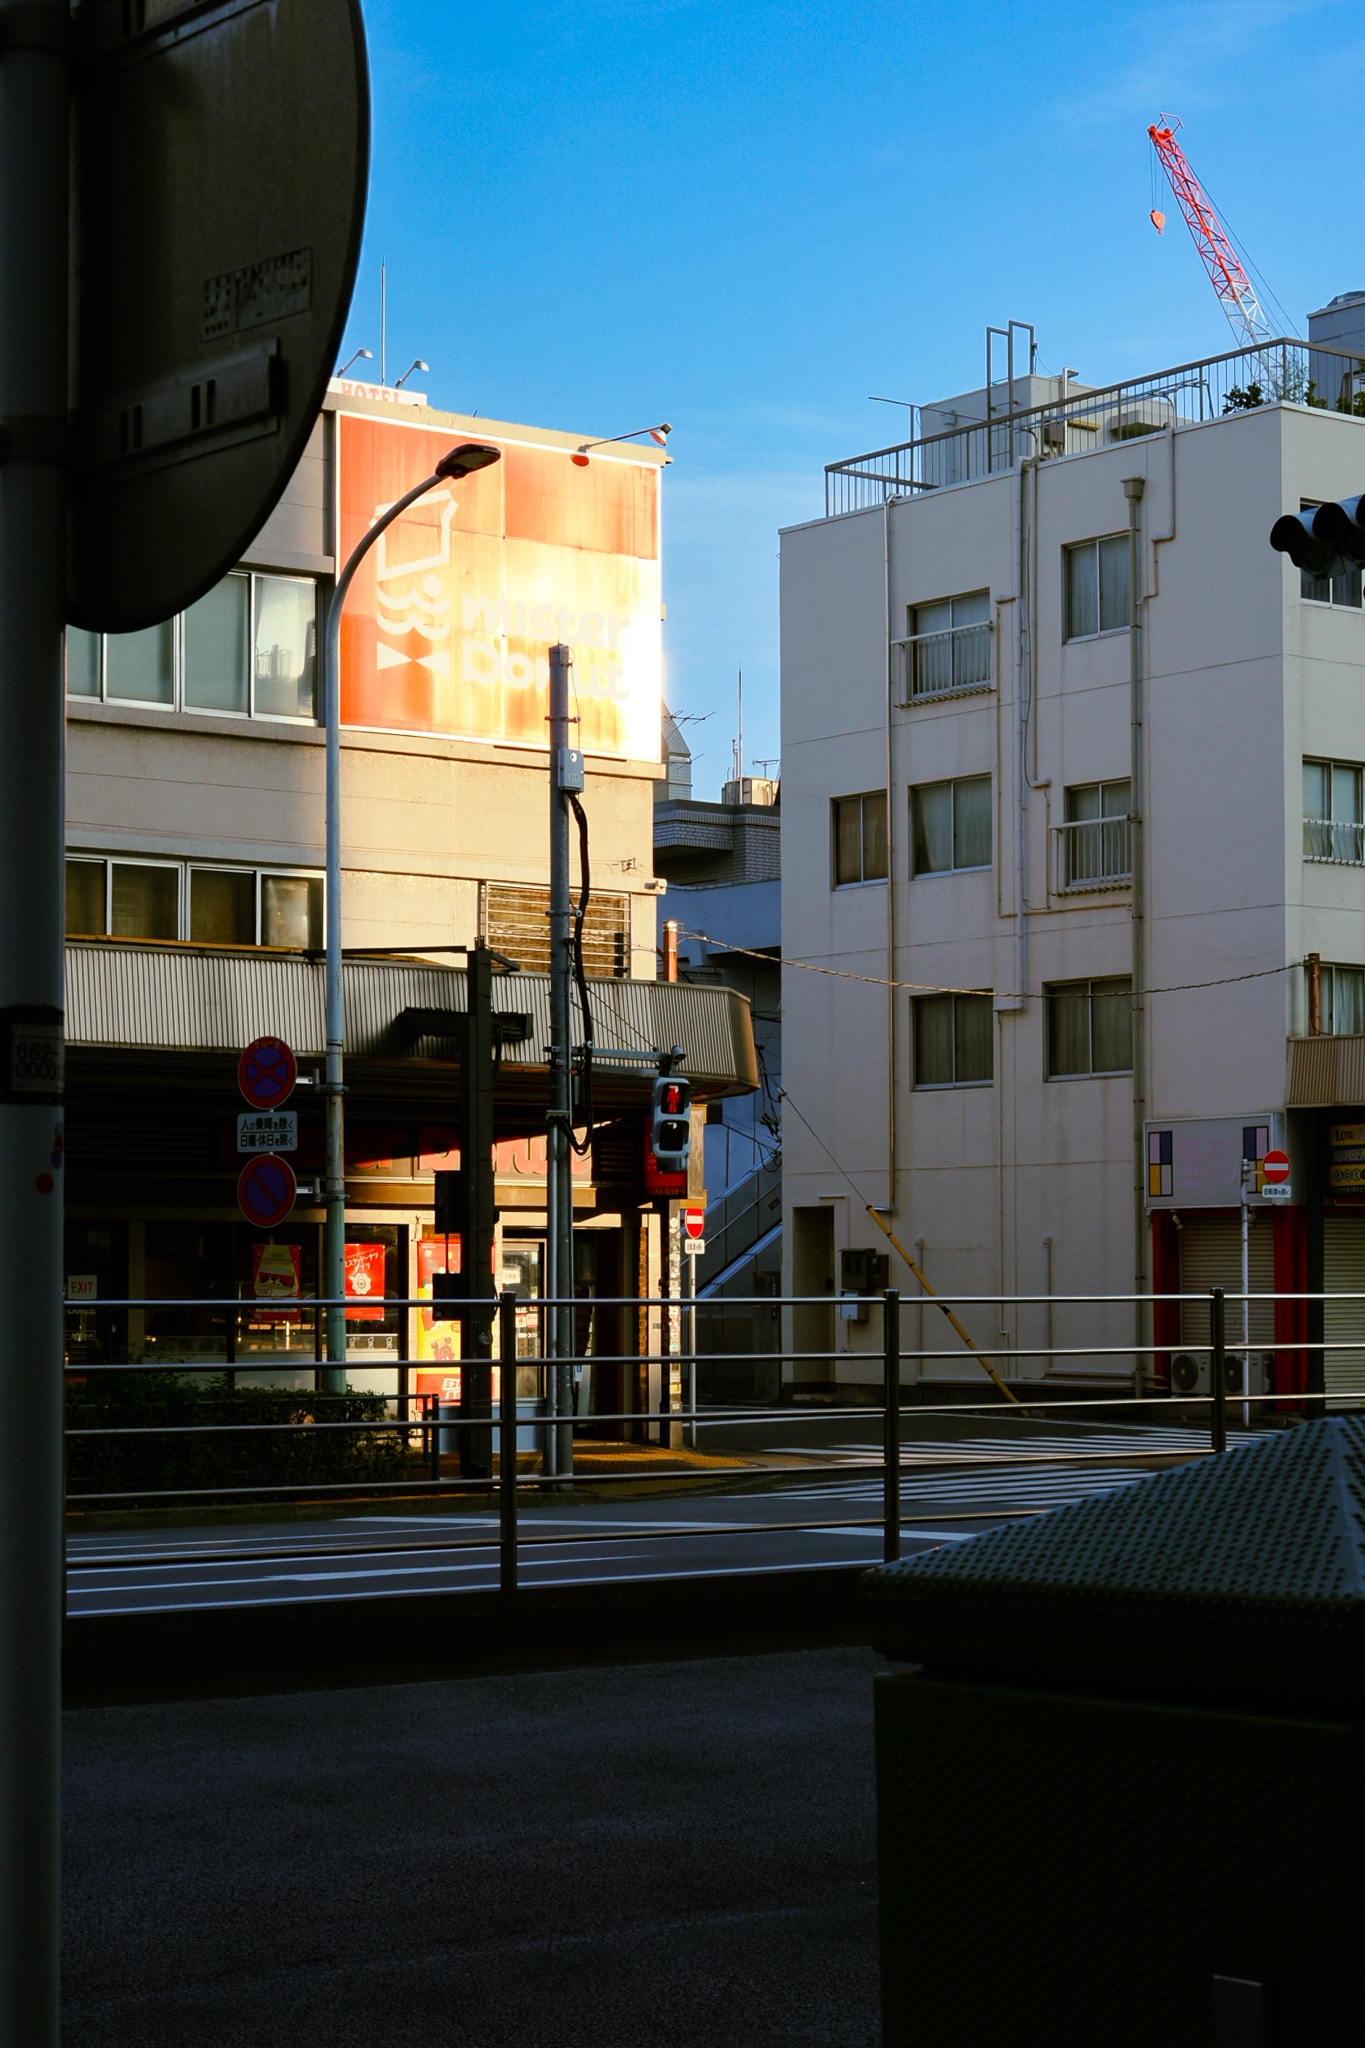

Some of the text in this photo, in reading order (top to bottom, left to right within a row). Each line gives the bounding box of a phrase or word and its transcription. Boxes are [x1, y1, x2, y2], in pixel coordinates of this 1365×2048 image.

[462, 594, 631, 650] Mister
[240, 1116, 293, 1132] 人の乗降を除く
[71, 1281, 94, 1293] EXIT
